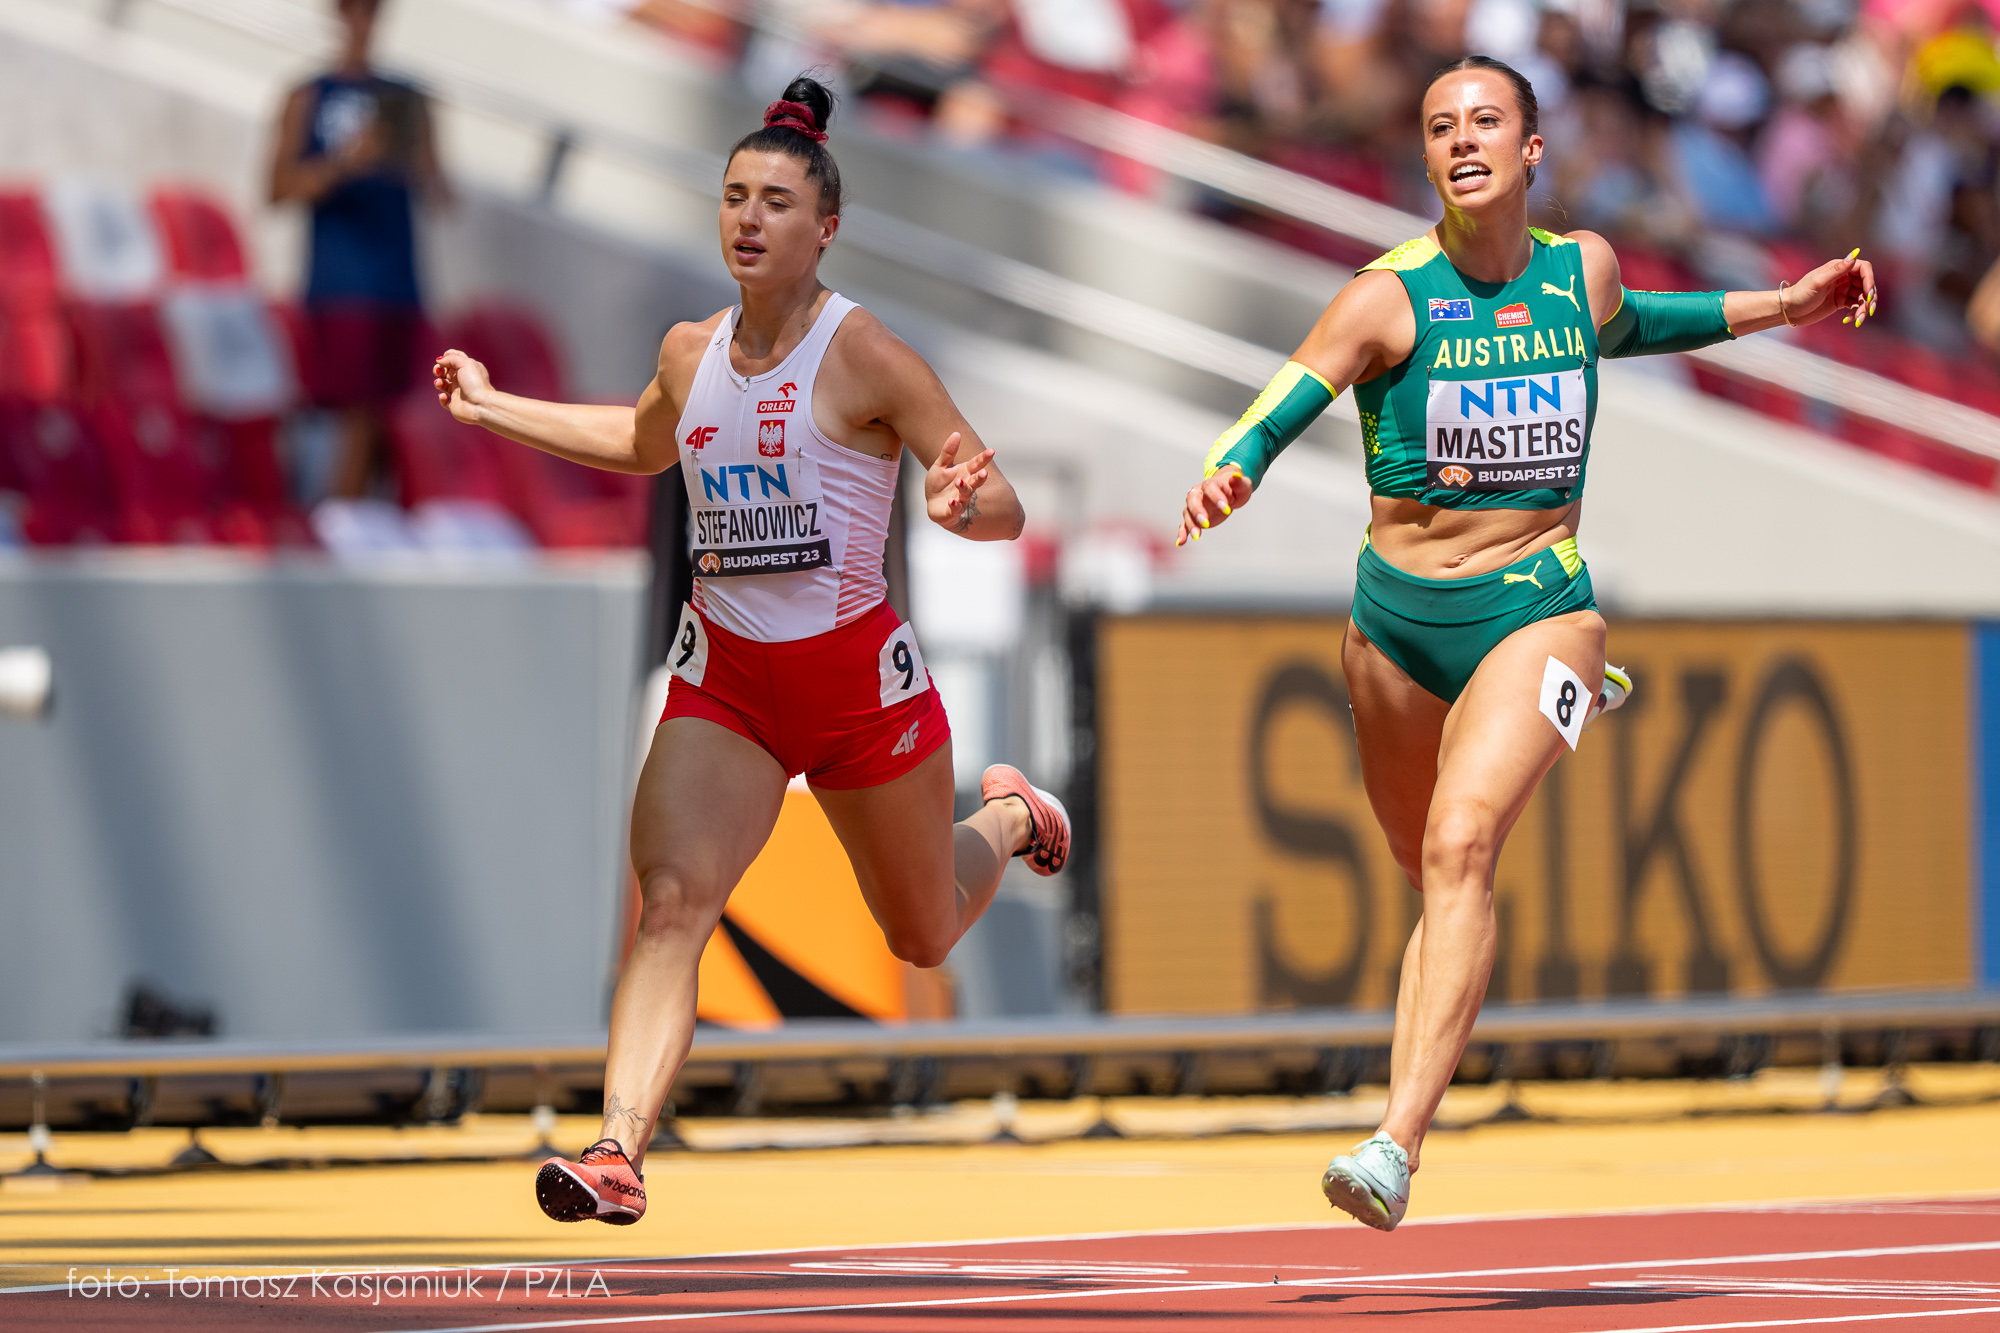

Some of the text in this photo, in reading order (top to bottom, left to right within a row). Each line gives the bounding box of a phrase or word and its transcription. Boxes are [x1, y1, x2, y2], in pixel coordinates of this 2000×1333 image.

[1497, 311, 1527, 320] CHEMIST
[1433, 327, 1586, 369] AUSTRALIA
[758, 401, 793, 412] ORLEN
[1460, 375, 1561, 419] NTN
[686, 426, 719, 449] 4F
[1436, 418, 1581, 460] MASTERS
[700, 463, 791, 503] NTN
[1478, 466, 1565, 483] BUDAPEST
[696, 502, 822, 545] STEFANOWICZ
[722, 549, 820, 569] BUDAPEST 23
[1556, 680, 1577, 728] 8
[891, 720, 919, 756] 4F
[1247, 648, 1858, 1008] SIKO
[601, 1174, 646, 1200] new balanc
